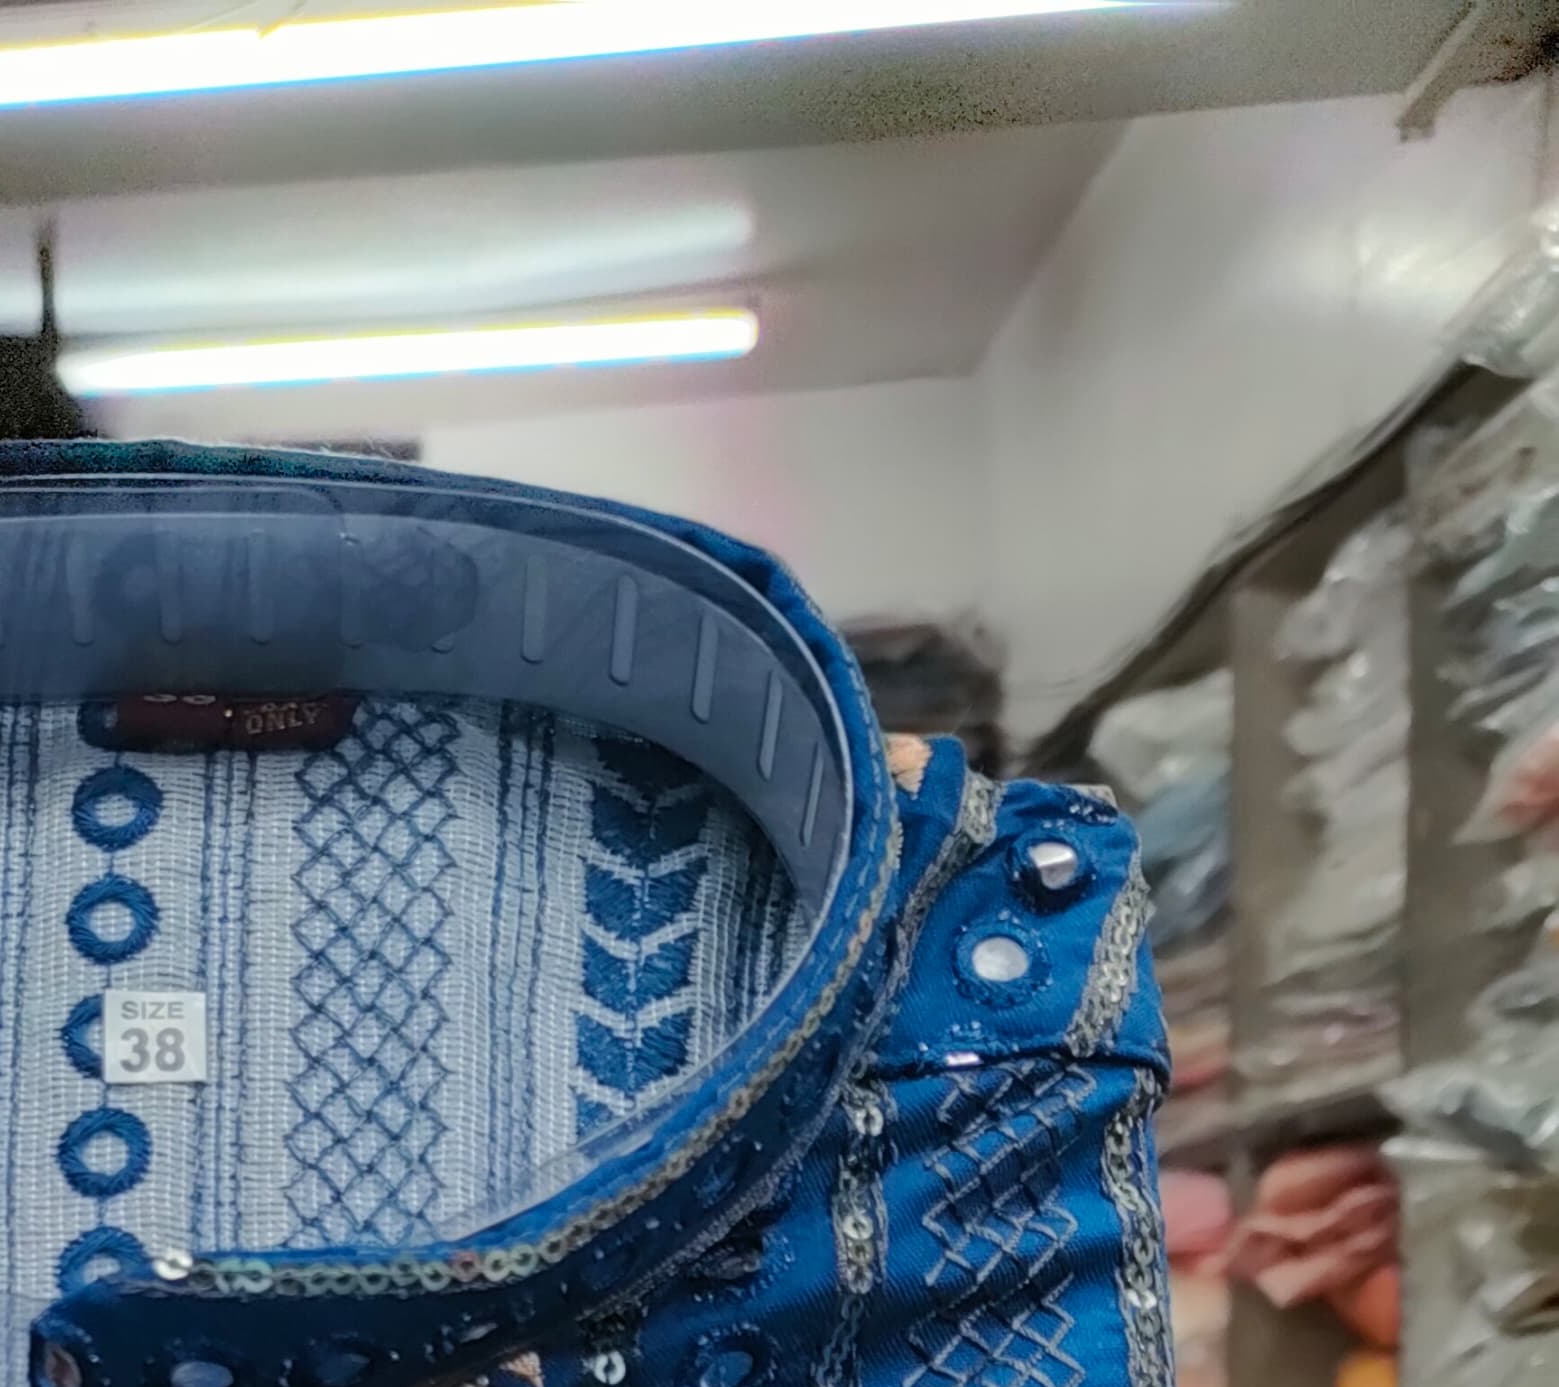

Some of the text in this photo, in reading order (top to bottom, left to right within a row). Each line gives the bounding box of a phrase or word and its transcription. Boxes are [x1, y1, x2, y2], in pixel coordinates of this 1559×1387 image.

[245, 704, 323, 734] ONLY
[121, 1001, 185, 1020] SIZE
[120, 1027, 186, 1073] 38
